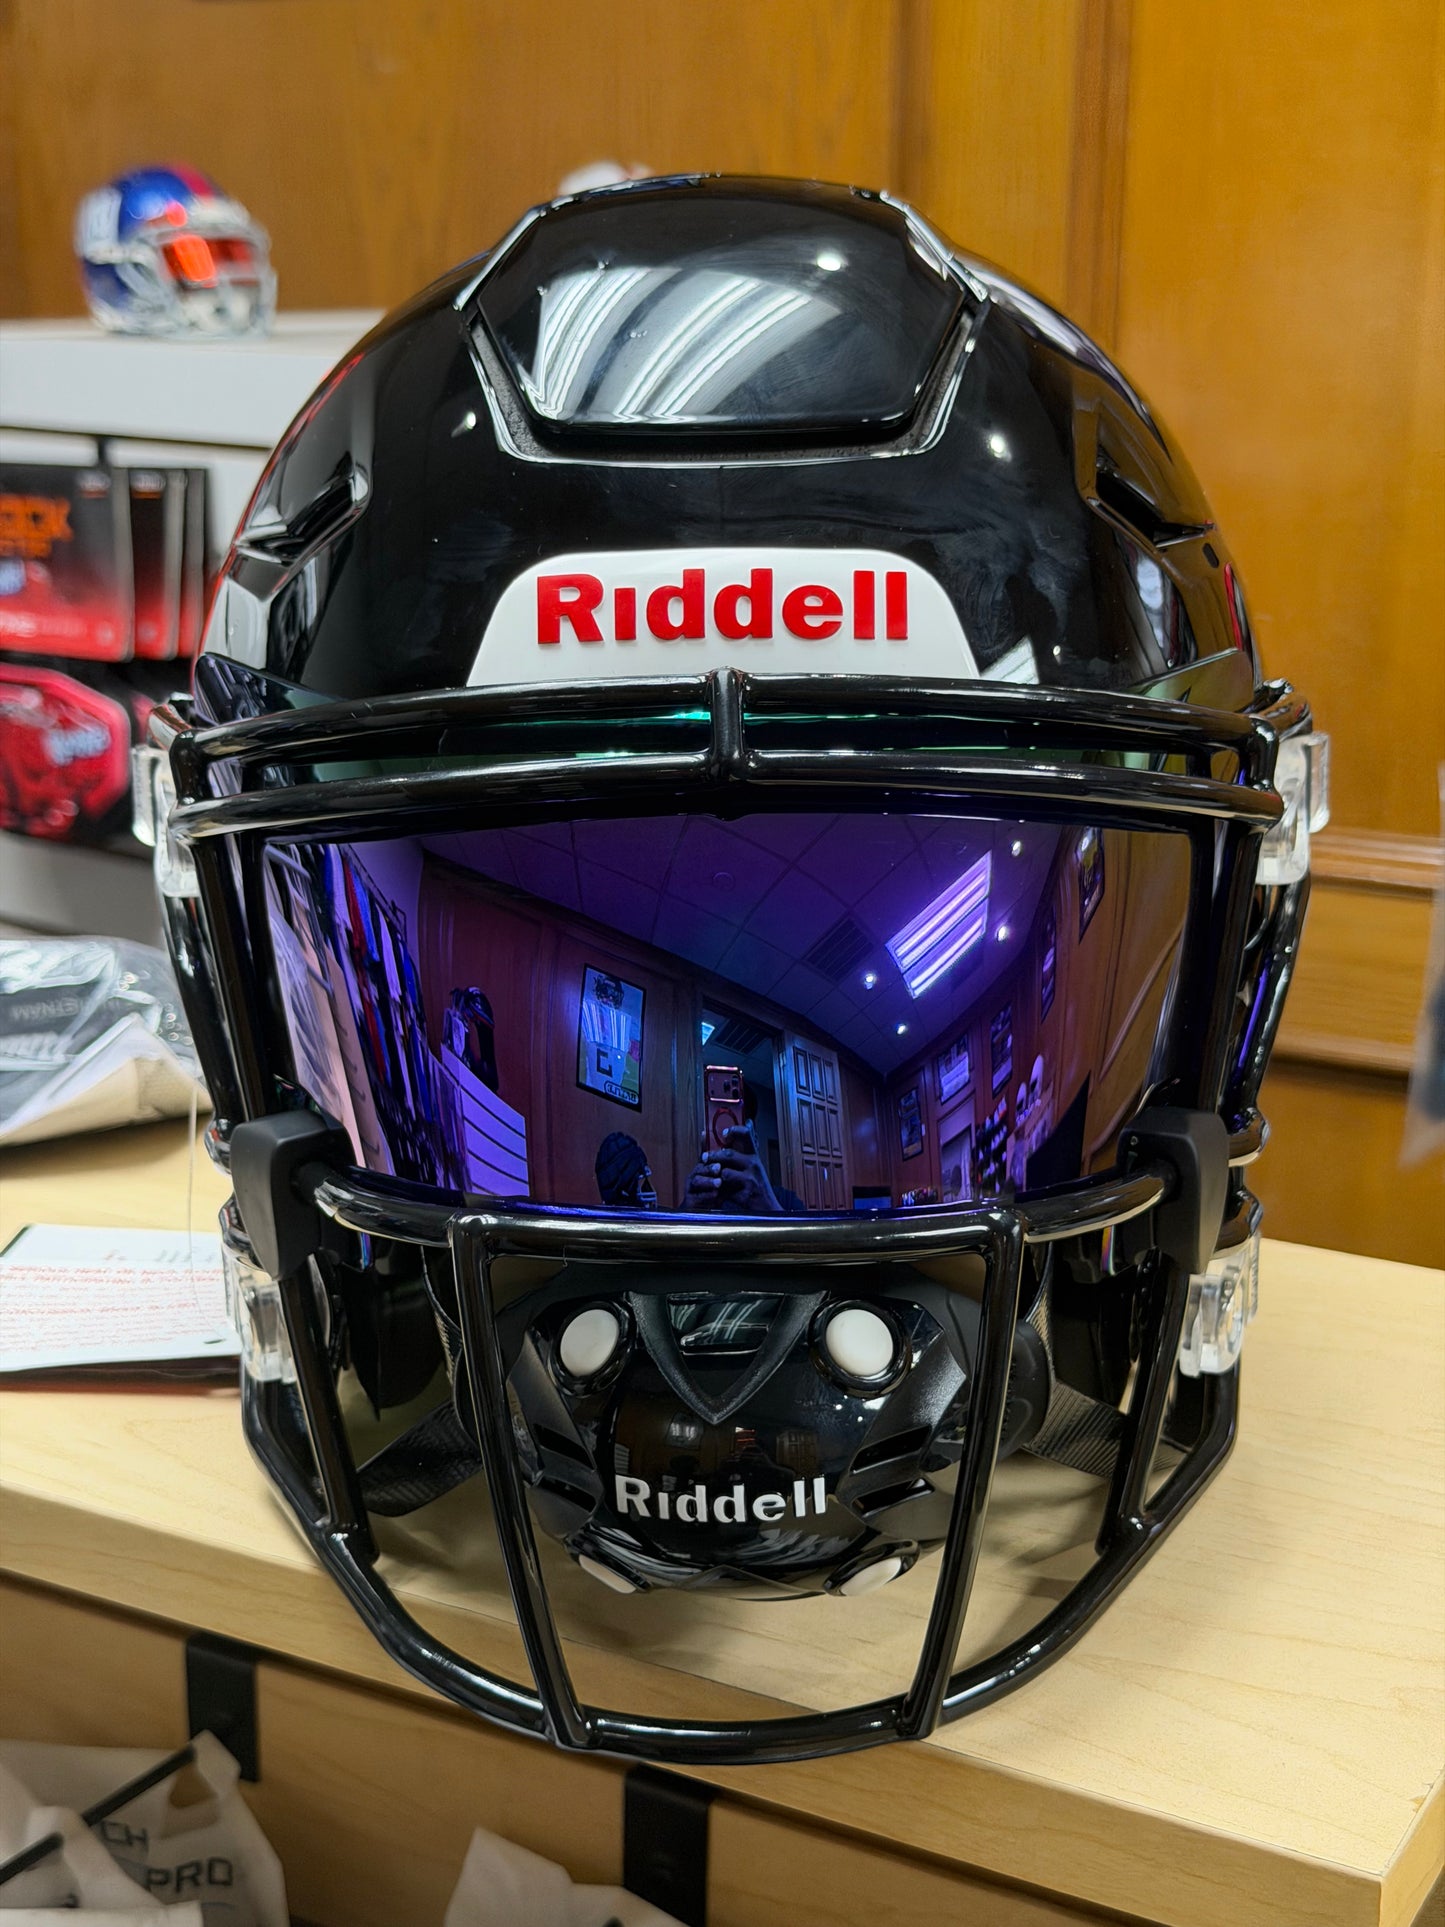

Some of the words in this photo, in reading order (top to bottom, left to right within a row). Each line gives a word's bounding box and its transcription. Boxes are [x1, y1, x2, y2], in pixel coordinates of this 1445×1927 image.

[537, 568, 908, 645] Riddell
[615, 1474, 826, 1523] Riddell
[147, 1857, 233, 1892] PRO
